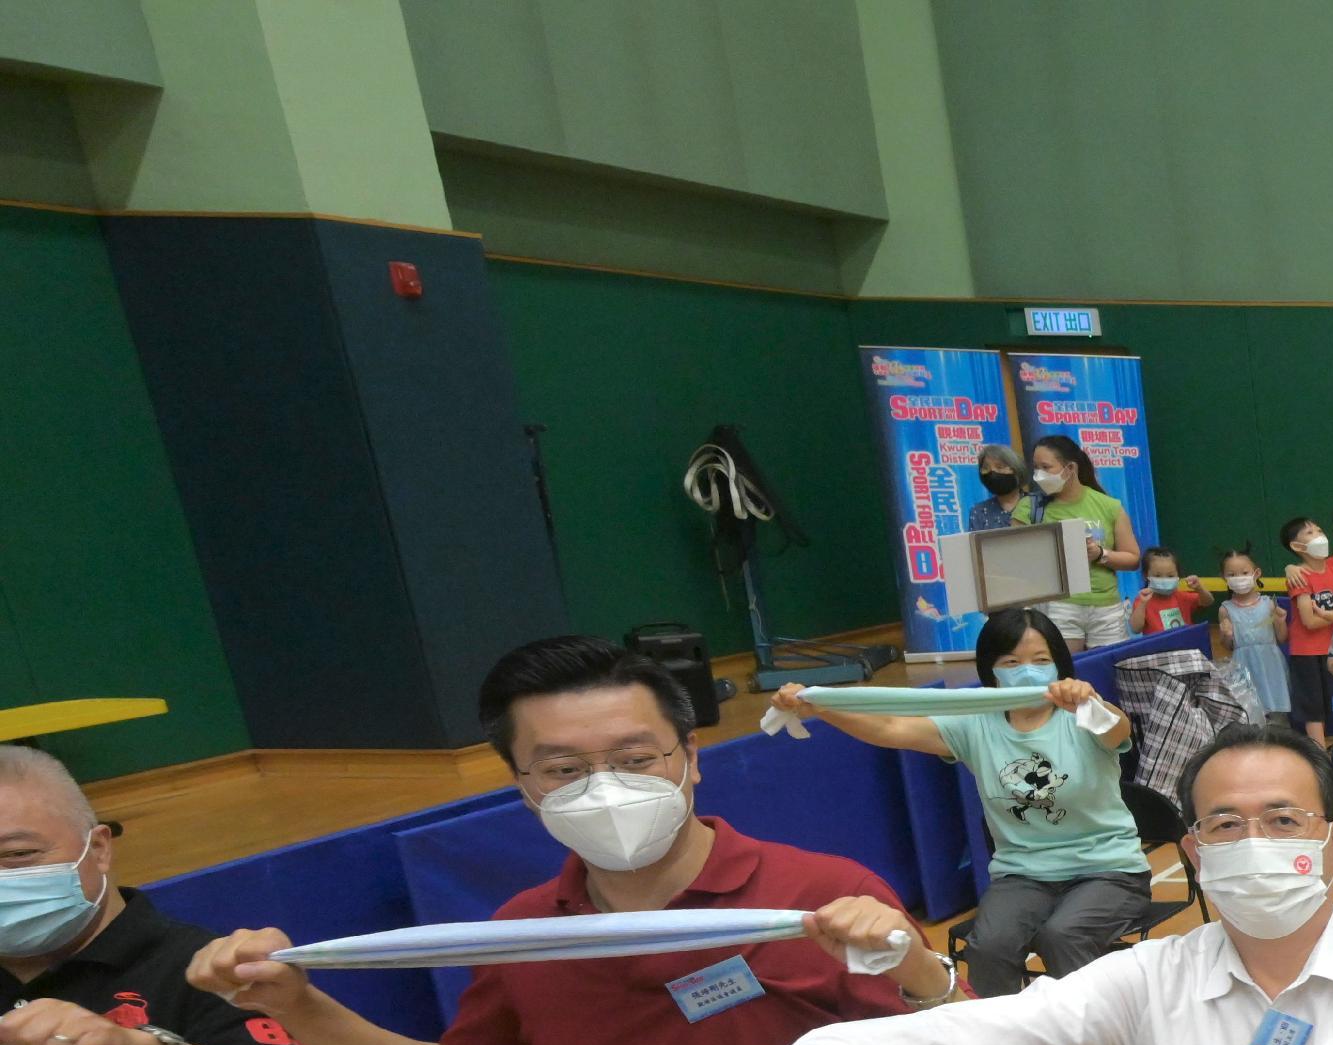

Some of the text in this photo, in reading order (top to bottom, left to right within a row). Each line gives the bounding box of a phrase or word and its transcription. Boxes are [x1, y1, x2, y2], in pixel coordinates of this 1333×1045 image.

[1032, 312, 1091, 331] EXIT 出口
[1112, 446, 1138, 457] Tong
